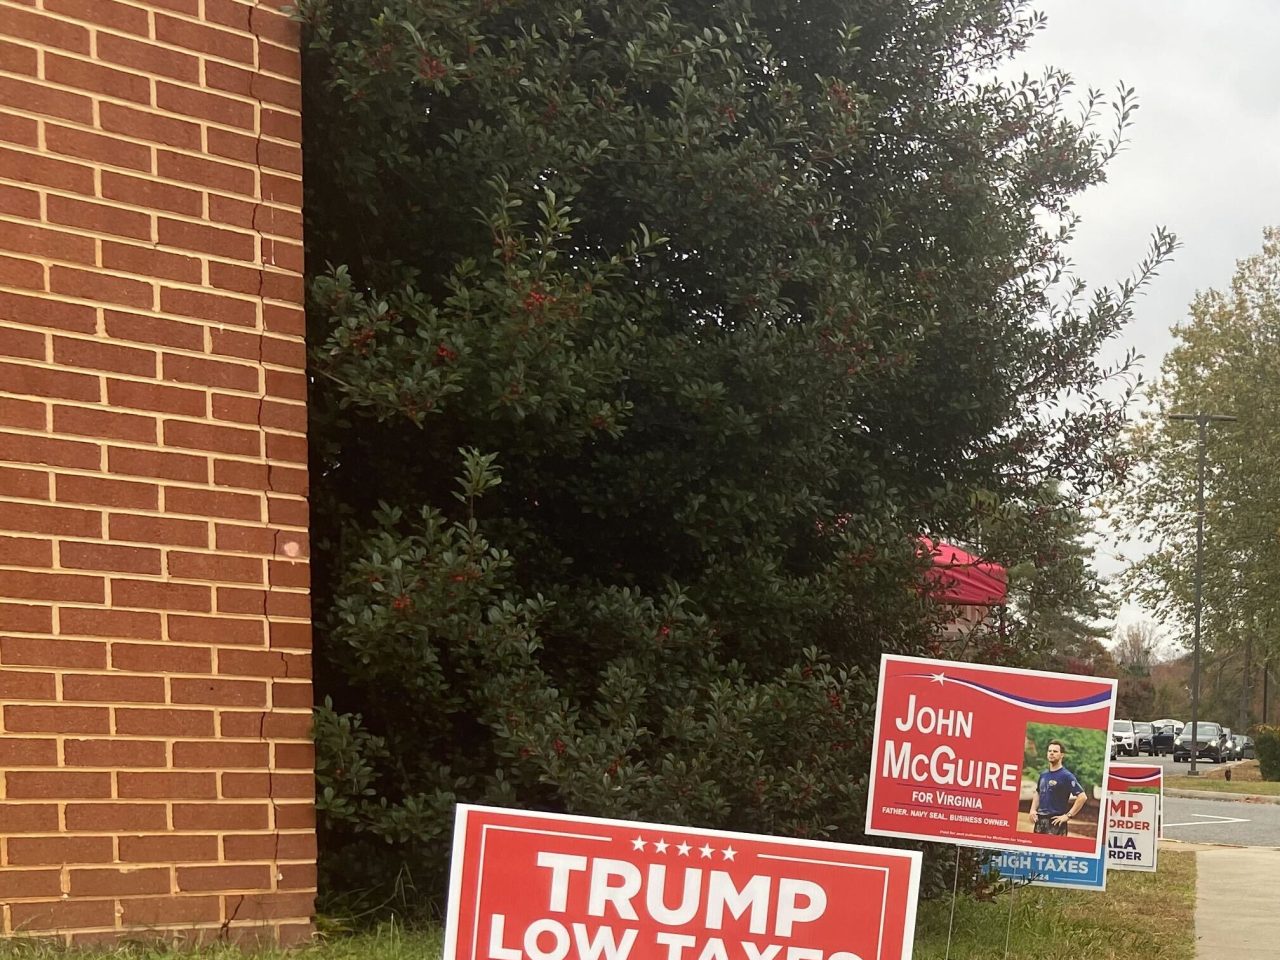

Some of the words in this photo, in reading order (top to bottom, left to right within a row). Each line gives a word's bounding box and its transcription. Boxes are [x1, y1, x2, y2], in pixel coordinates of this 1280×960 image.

[895, 694, 974, 738] JOHN
[912, 791, 933, 803] FOR
[935, 790, 983, 809] VIRGINIA
[882, 806, 909, 816] FATHER.
[910, 809, 927, 818] NAVY
[929, 812, 948, 821] SEAL.
[950, 815, 982, 825] BUSINESS
[984, 819, 1010, 827] OWNER.
[991, 854, 1031, 869] HIGH
[1036, 857, 1089, 873] TAXES
[537, 851, 828, 938] TRUMP
